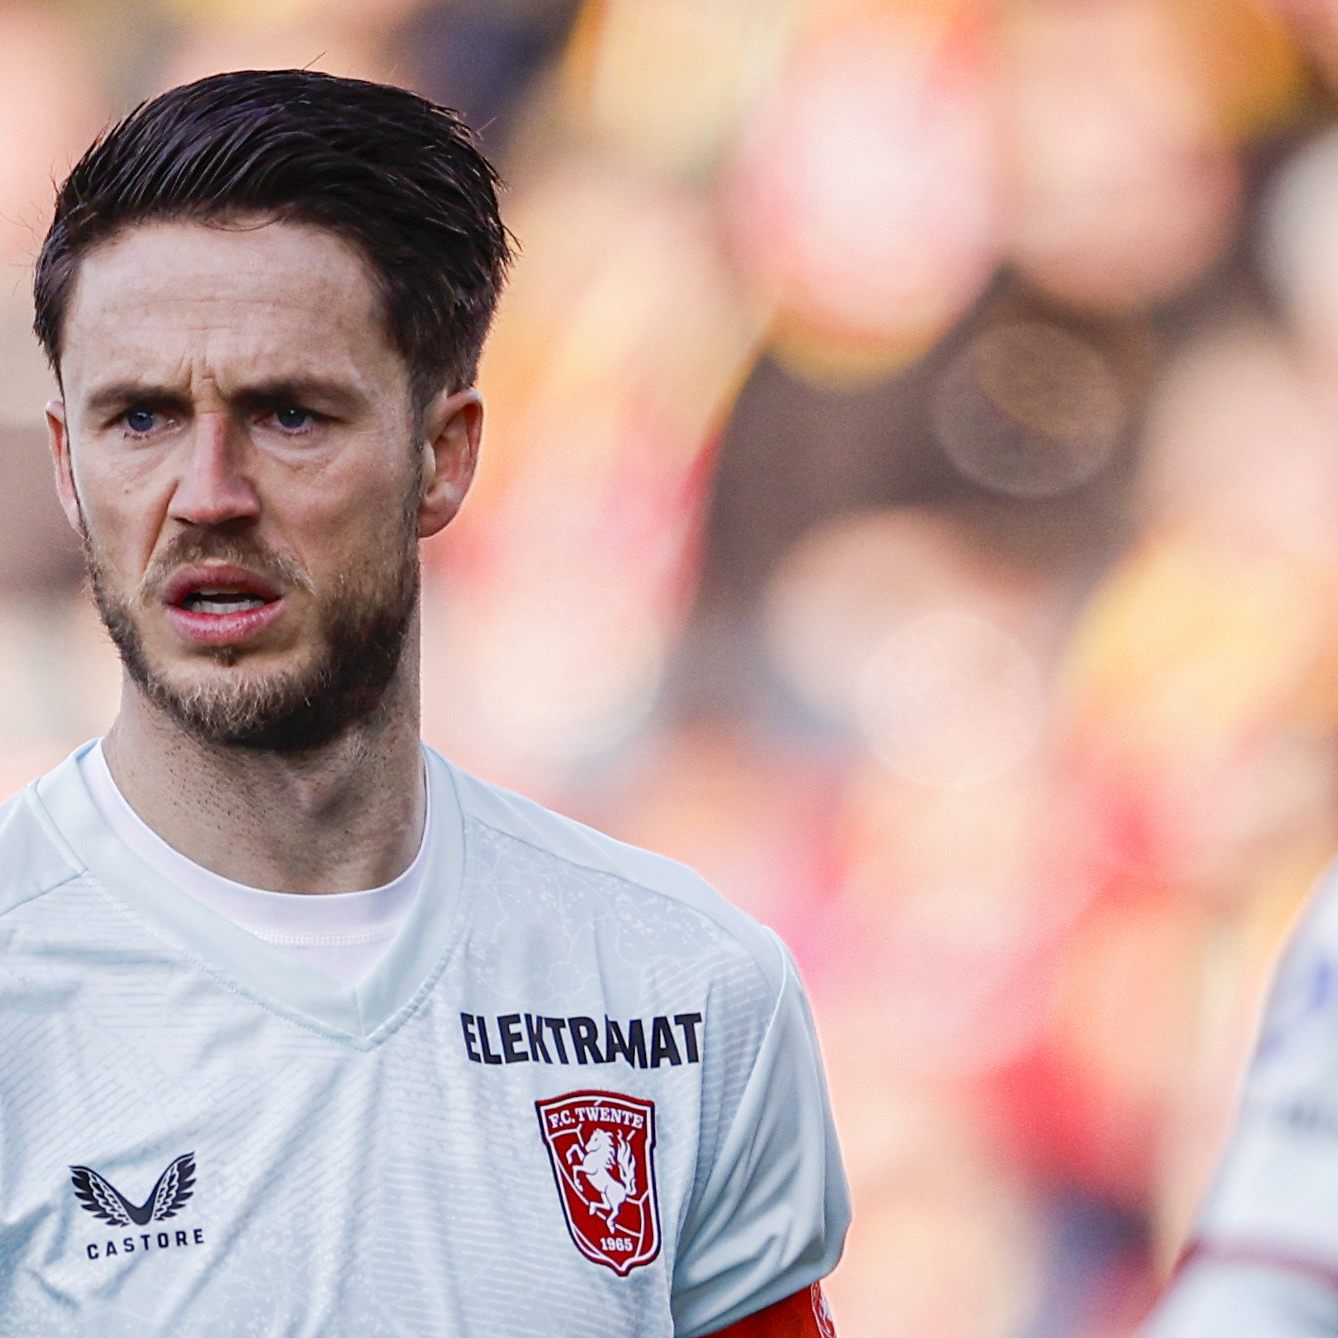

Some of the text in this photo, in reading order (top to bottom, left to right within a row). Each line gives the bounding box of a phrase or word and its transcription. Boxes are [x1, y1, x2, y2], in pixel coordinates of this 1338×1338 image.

[460, 1012, 702, 1069] ELEKTRAMAT
[548, 1106, 644, 1129] F.C. TWENTE
[86, 1228, 204, 1260] CASTORE
[600, 1237, 633, 1251] 1965
